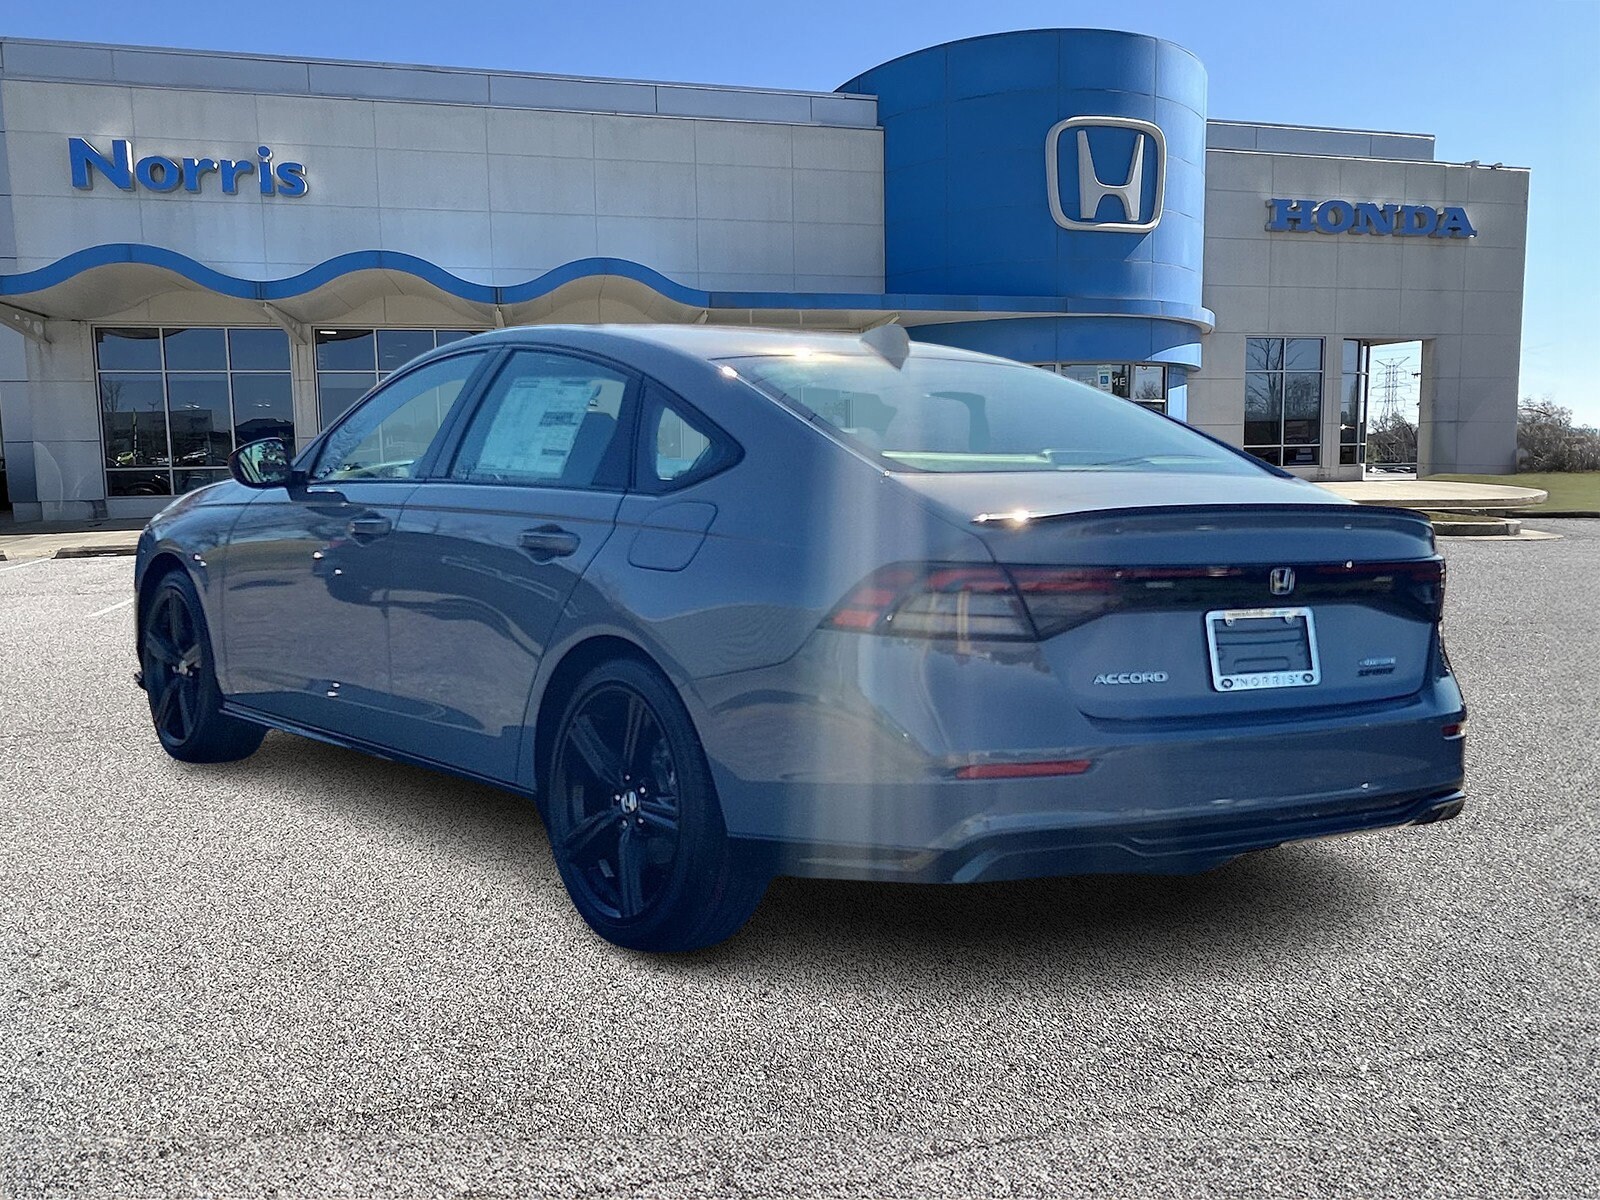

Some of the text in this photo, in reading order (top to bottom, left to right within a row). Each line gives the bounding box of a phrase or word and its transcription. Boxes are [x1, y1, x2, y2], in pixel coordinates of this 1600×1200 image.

[68, 137, 309, 197] Norris
[1265, 198, 1477, 238] HONDA
[1094, 671, 1169, 685] ACCORD
